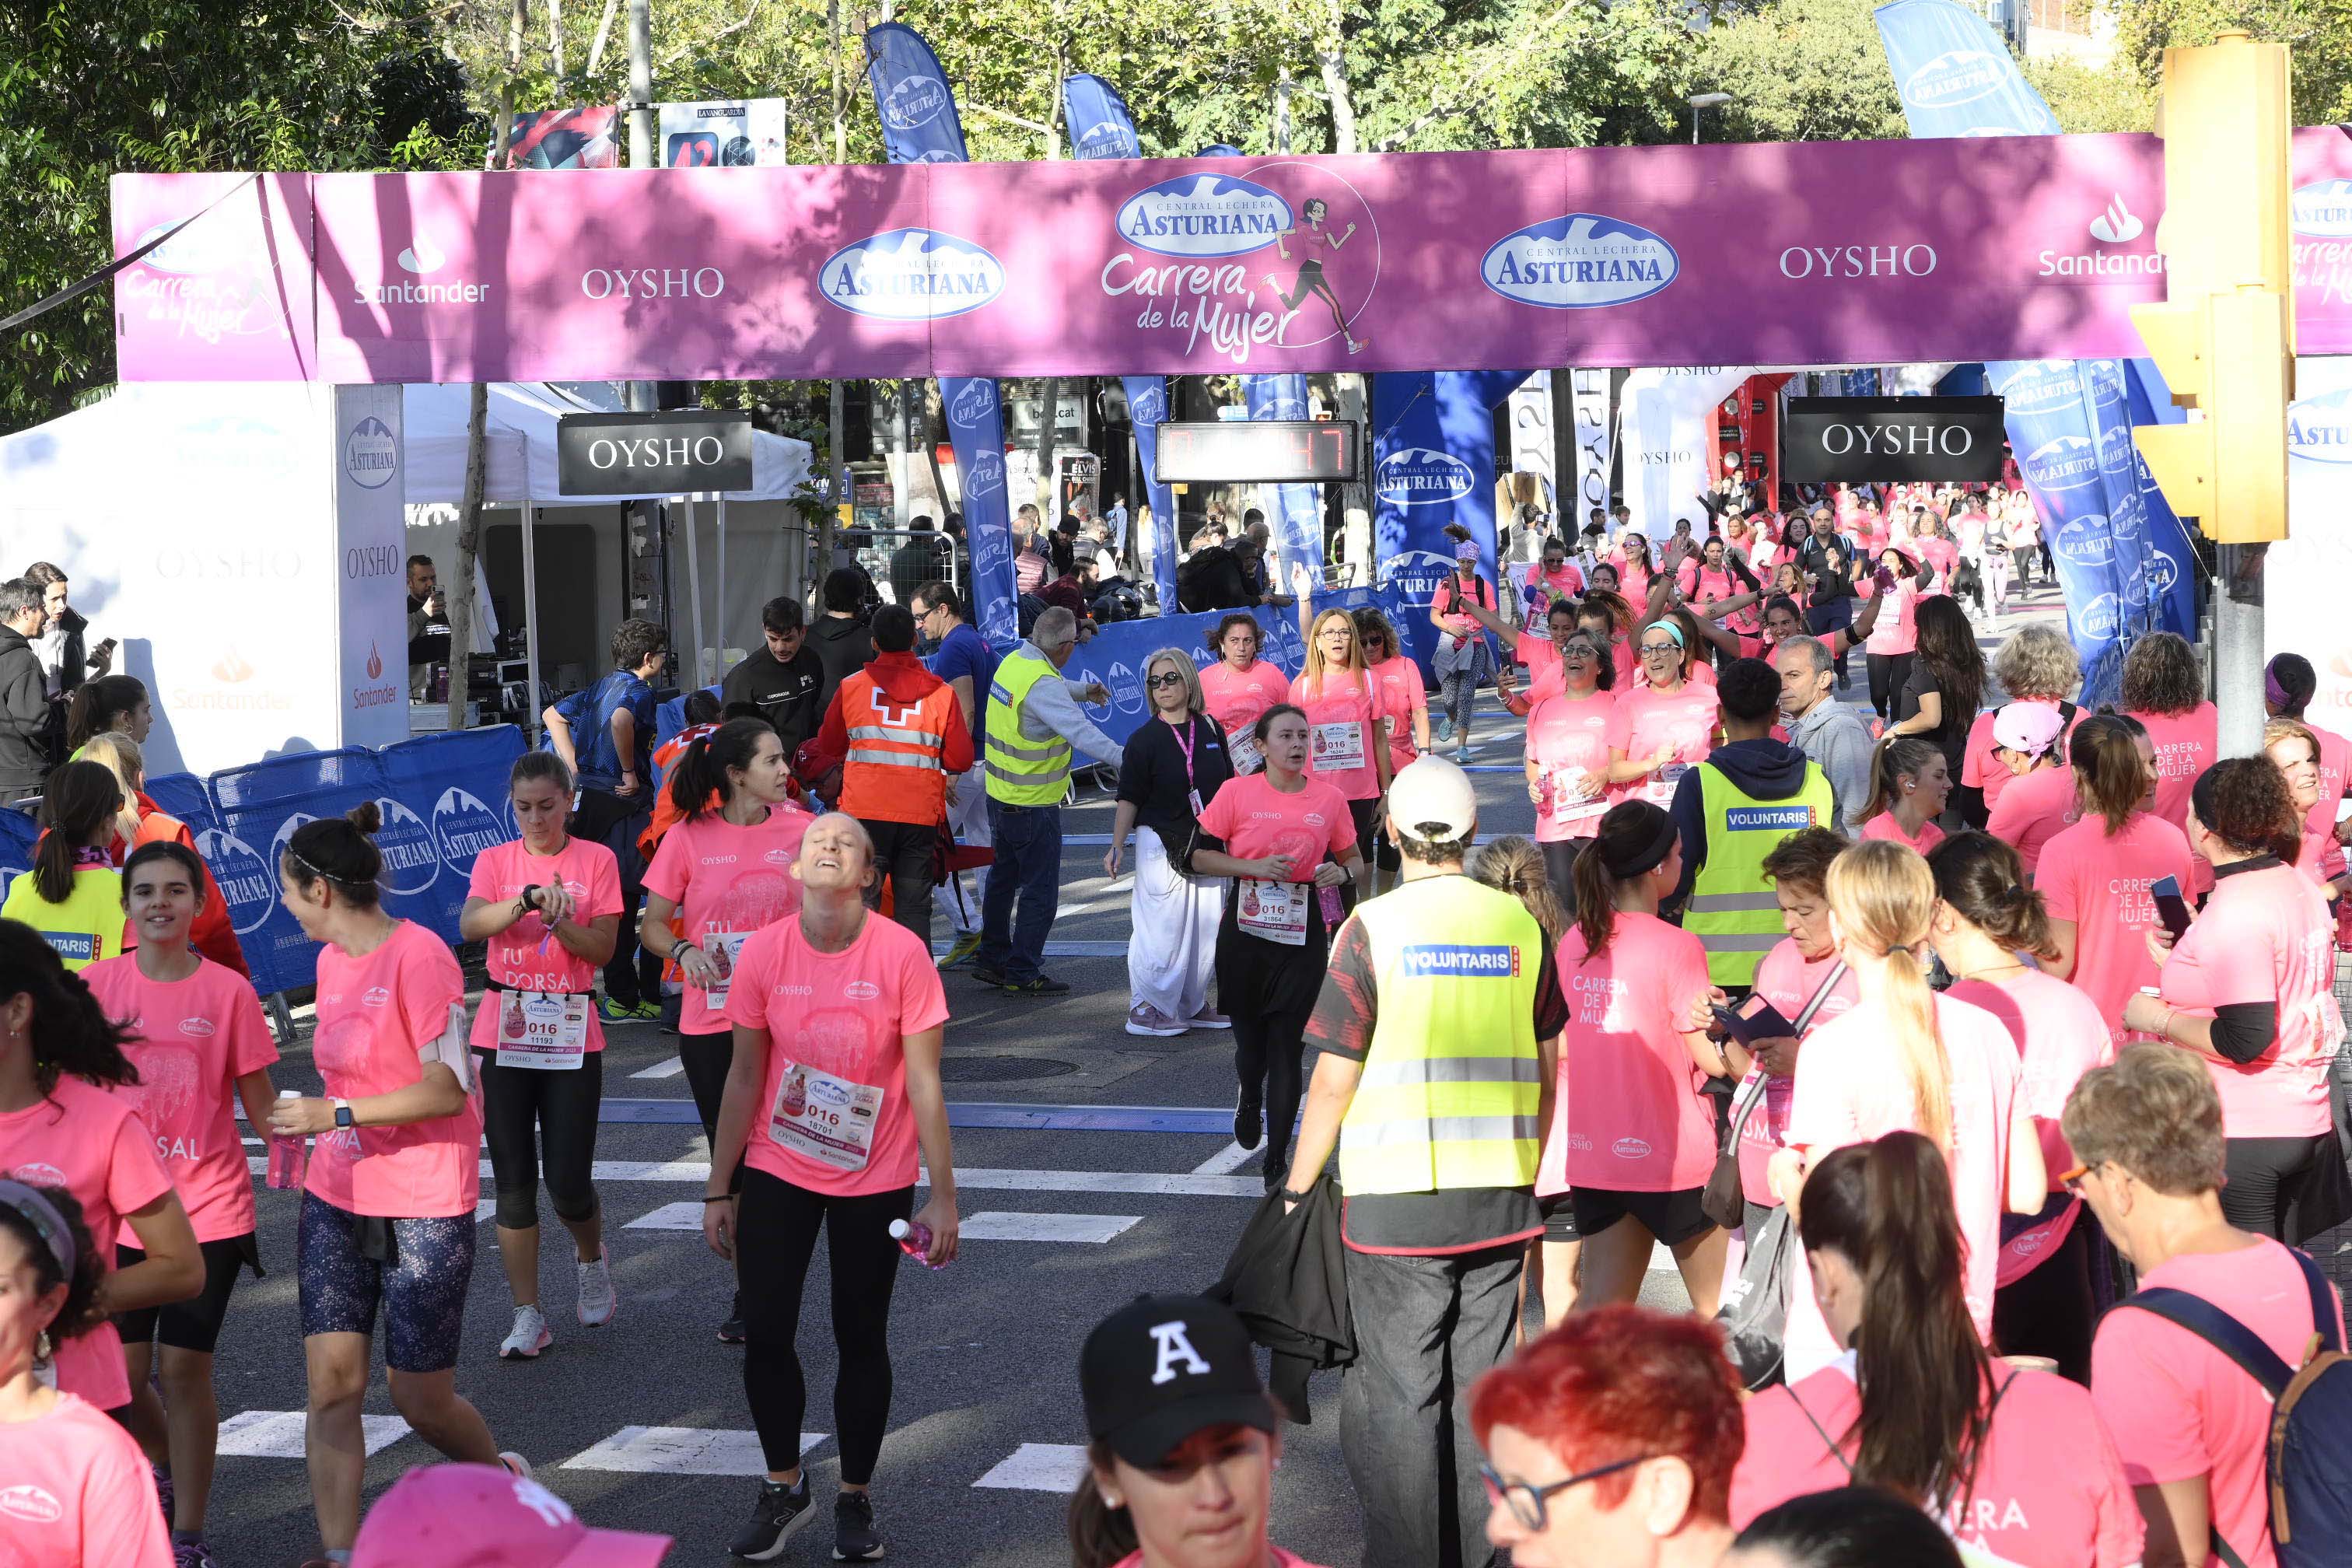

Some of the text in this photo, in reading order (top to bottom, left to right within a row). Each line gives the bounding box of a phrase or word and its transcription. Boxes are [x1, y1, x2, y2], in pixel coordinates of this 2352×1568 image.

[1157, 201, 1274, 210] CENTRAL LECHERA
[1130, 205, 1279, 236] ASTURIANA
[1526, 245, 1657, 257] CENTRAL LECHERA
[1496, 250, 1663, 285] ASTURIANA
[1779, 244, 1937, 278] OYSHO
[833, 262, 990, 296] ASTURIANA
[1101, 252, 1247, 296] Carrera
[354, 279, 490, 304] Santander
[581, 267, 725, 299] OYSHO
[1137, 290, 1301, 365] de la Mujer
[1822, 424, 1972, 456] OYSHO
[348, 443, 394, 471] ASTURIANA
[589, 436, 723, 470] OYSHO
[1071, 464, 1096, 474] ELVIS
[1379, 471, 1467, 492] ASTURIANA
[348, 544, 398, 579] OYSHO
[354, 684, 397, 709] Santander
[1111, 683, 1142, 703] ASTURIANA
[2157, 753, 2194, 767] DE LA
[2156, 764, 2197, 777] MUJER
[446, 816, 492, 830] CENTRAL LECHERA
[1252, 811, 1282, 820] OYSHO
[1728, 812, 1808, 825] VOLUNTARIS
[398, 827, 425, 837] LECHERA
[443, 824, 504, 860] ASTURIANA
[383, 845, 434, 873] STURIANA
[702, 855, 737, 866] OYSHO
[1262, 905, 1285, 915] 016
[502, 948, 523, 965] TU
[1405, 952, 1510, 969] VOLUNTARIS
[775, 985, 813, 996] OYSHO
[1584, 992, 1600, 1008] DE
[528, 1005, 561, 1013] ASTURIANA
[528, 1022, 558, 1034] 016
[505, 1055, 531, 1063] OYSHO
[812, 1086, 846, 1103] ASTURIANA
[808, 1104, 840, 1125] 016
[782, 1121, 807, 1136] CARRERA
[824, 1137, 845, 1151] MUJER
[809, 1120, 833, 1136] 18701
[778, 1130, 806, 1148] OYSHO
[827, 1151, 859, 1165] Santander
[1149, 1320, 1210, 1385] A
